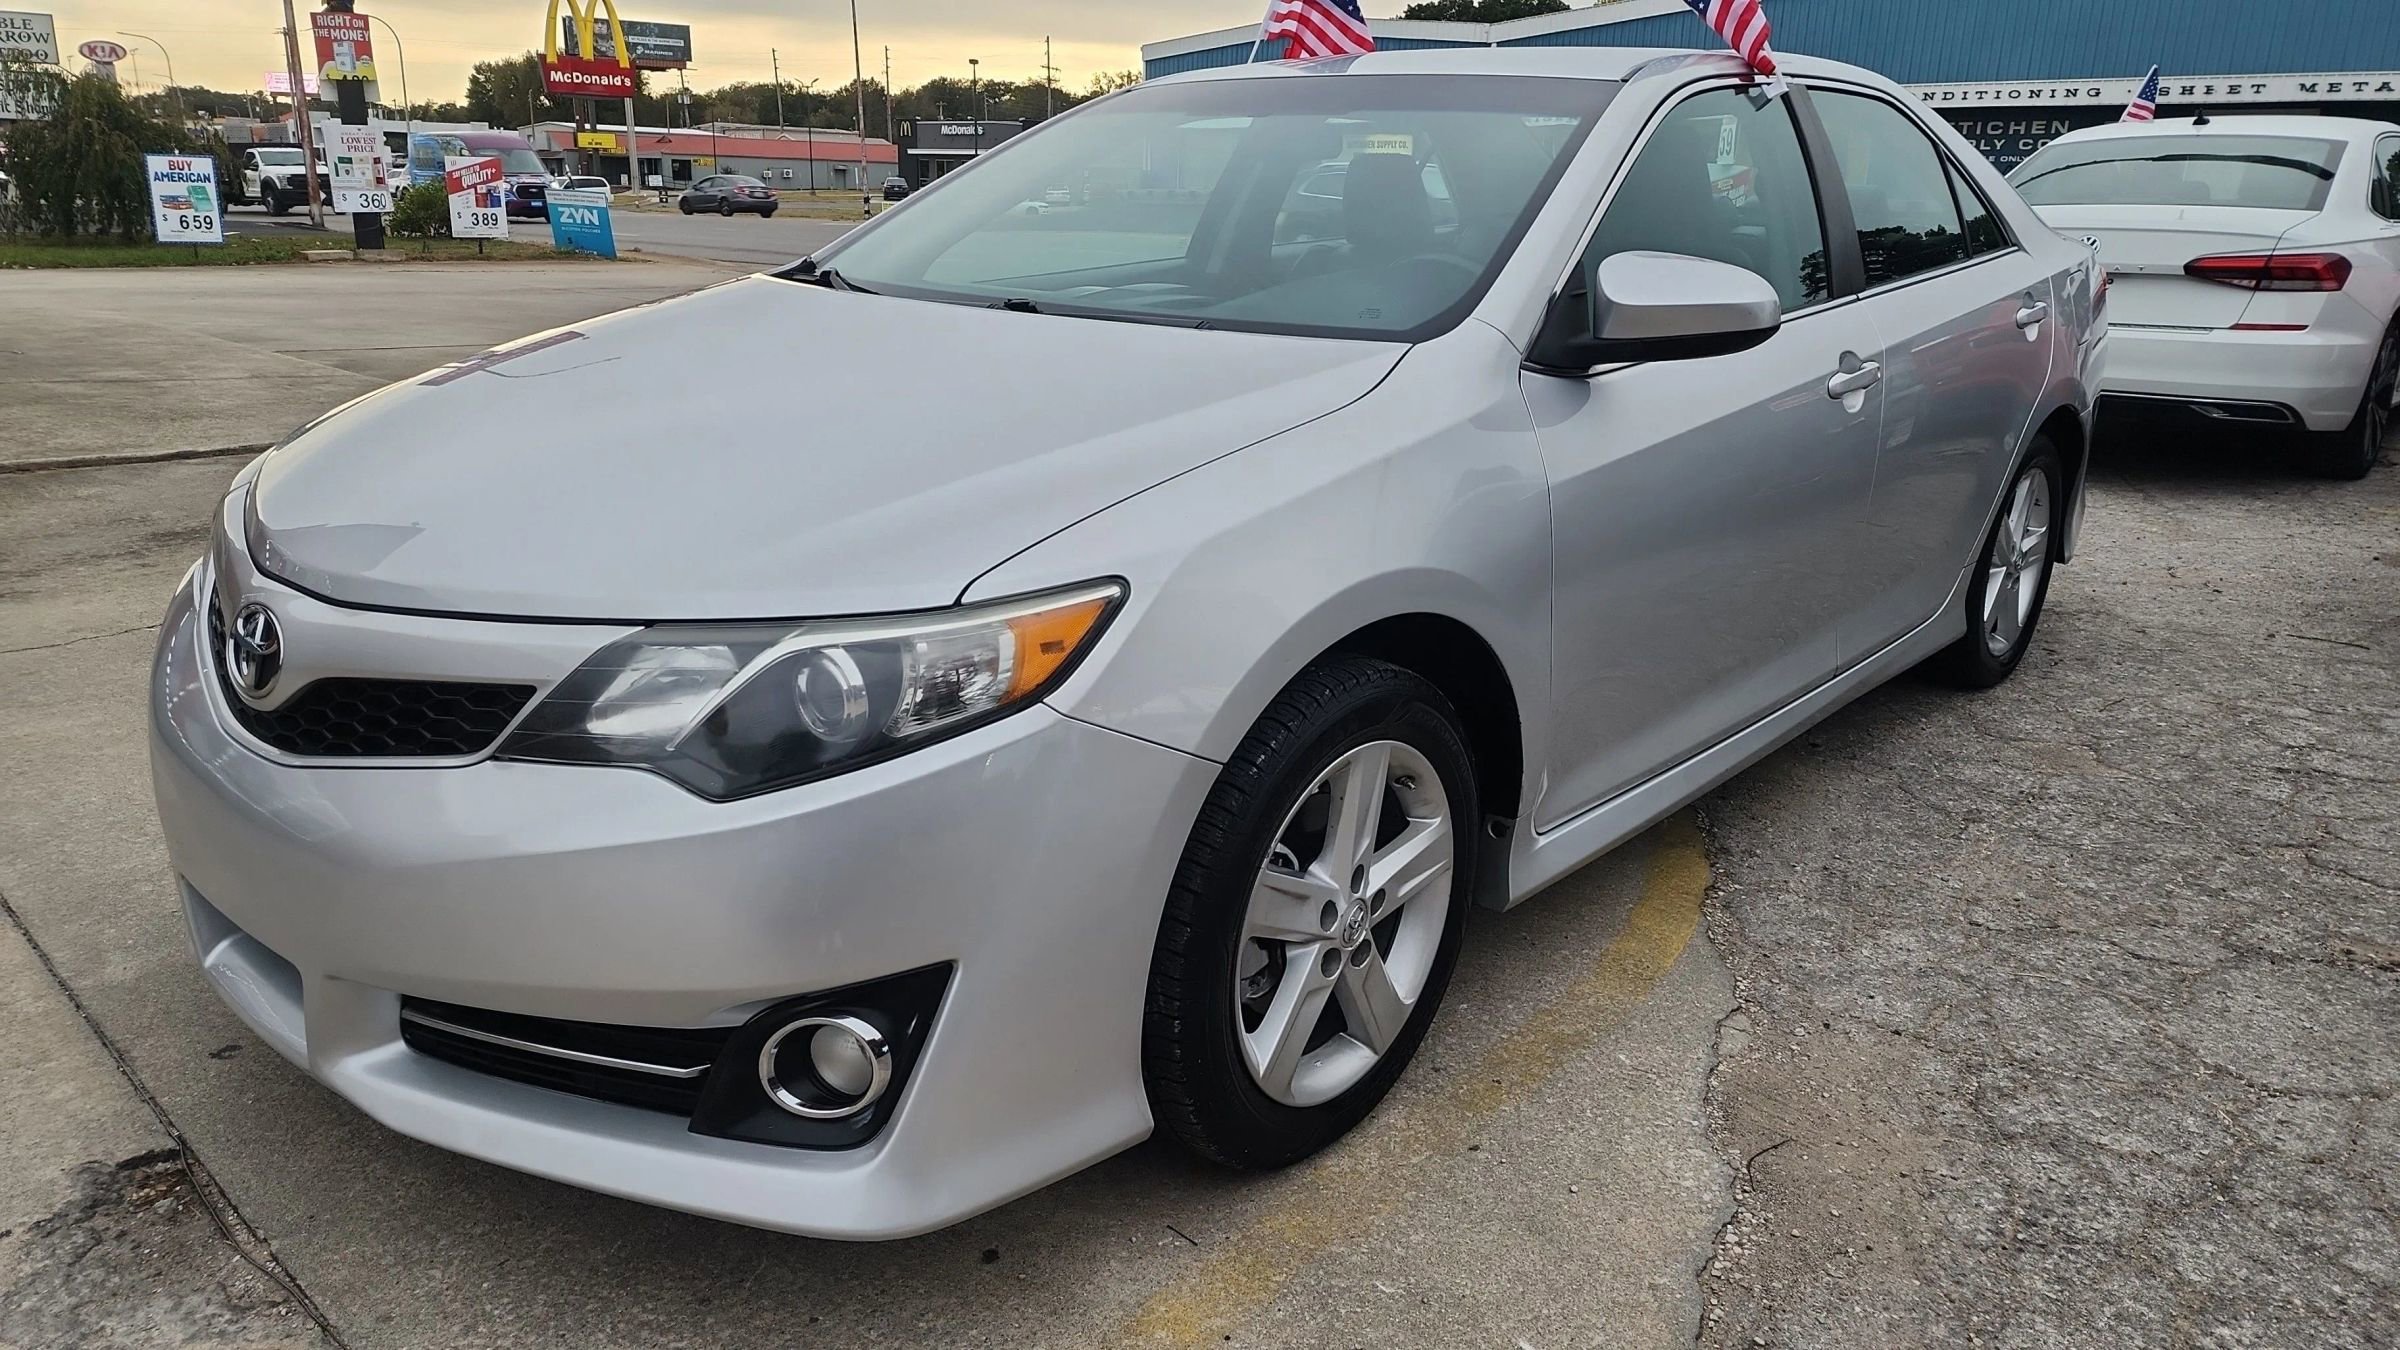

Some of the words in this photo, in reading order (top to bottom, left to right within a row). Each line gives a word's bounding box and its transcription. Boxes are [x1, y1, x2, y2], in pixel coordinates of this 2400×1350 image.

[316, 14, 351, 27] RIGHT
[353, 18, 365, 28] ON
[314, 28, 330, 38] THE
[330, 28, 370, 42] MONEY
[87, 44, 120, 59] KIA
[550, 70, 632, 87] McDonald's
[2299, 81, 2395, 93] META
[1922, 87, 2102, 101] NDITIONING
[1950, 119, 2070, 135] TICHEN
[340, 137, 376, 145] LOWEST
[1377, 140, 1397, 149] SUPPLY
[347, 145, 375, 153] PRICE
[168, 160, 192, 171] BUY
[153, 171, 212, 183] AMERICAN
[341, 193, 348, 201] $
[162, 214, 168, 222] $
[457, 211, 462, 219] $
[557, 206, 600, 226] ZYN
